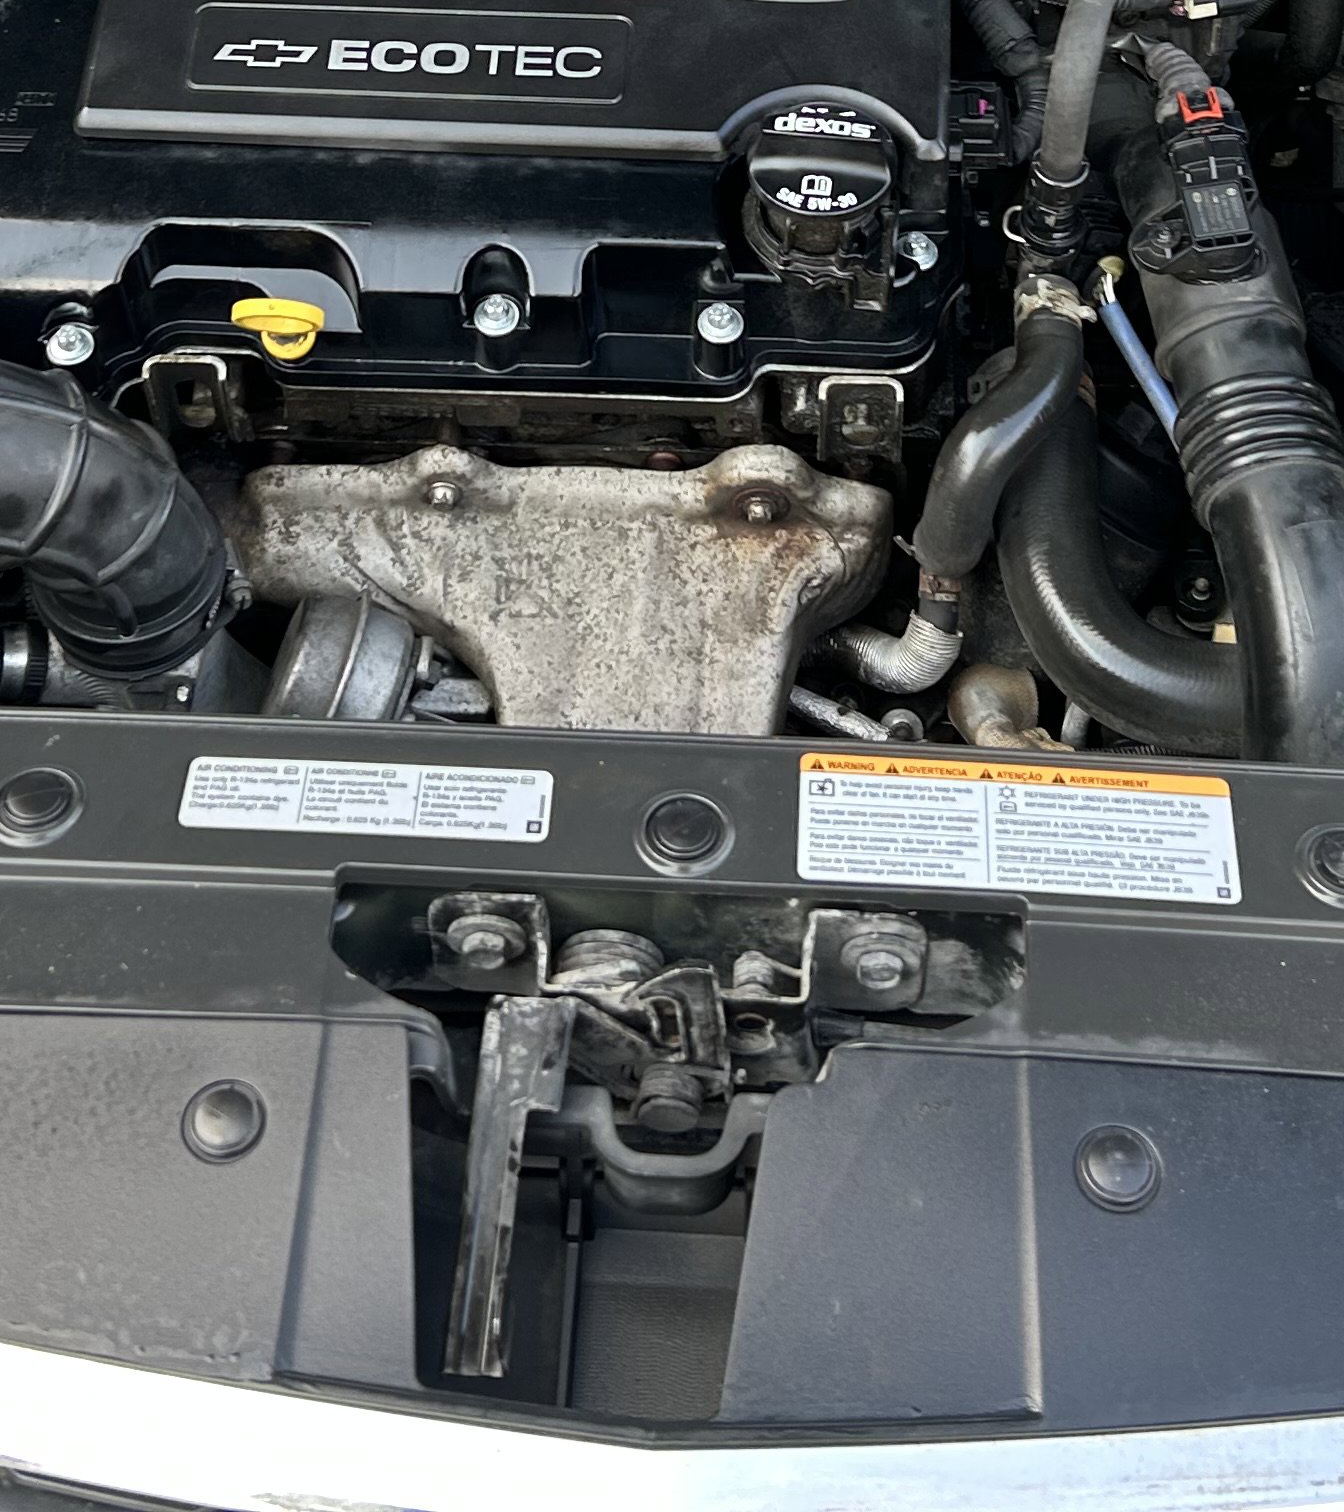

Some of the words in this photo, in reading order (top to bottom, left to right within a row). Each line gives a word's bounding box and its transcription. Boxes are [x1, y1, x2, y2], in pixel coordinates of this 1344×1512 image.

[327, 39, 603, 78] ECOTEC
[774, 112, 873, 139] dexos
[776, 187, 805, 208] SAE
[807, 192, 857, 211] 5W-30
[827, 760, 874, 771] WARNING
[902, 765, 967, 777] ADVERTENCIA
[997, 769, 1042, 782] ATENÇÃO
[1069, 776, 1149, 789] AVERTISSEMENT
